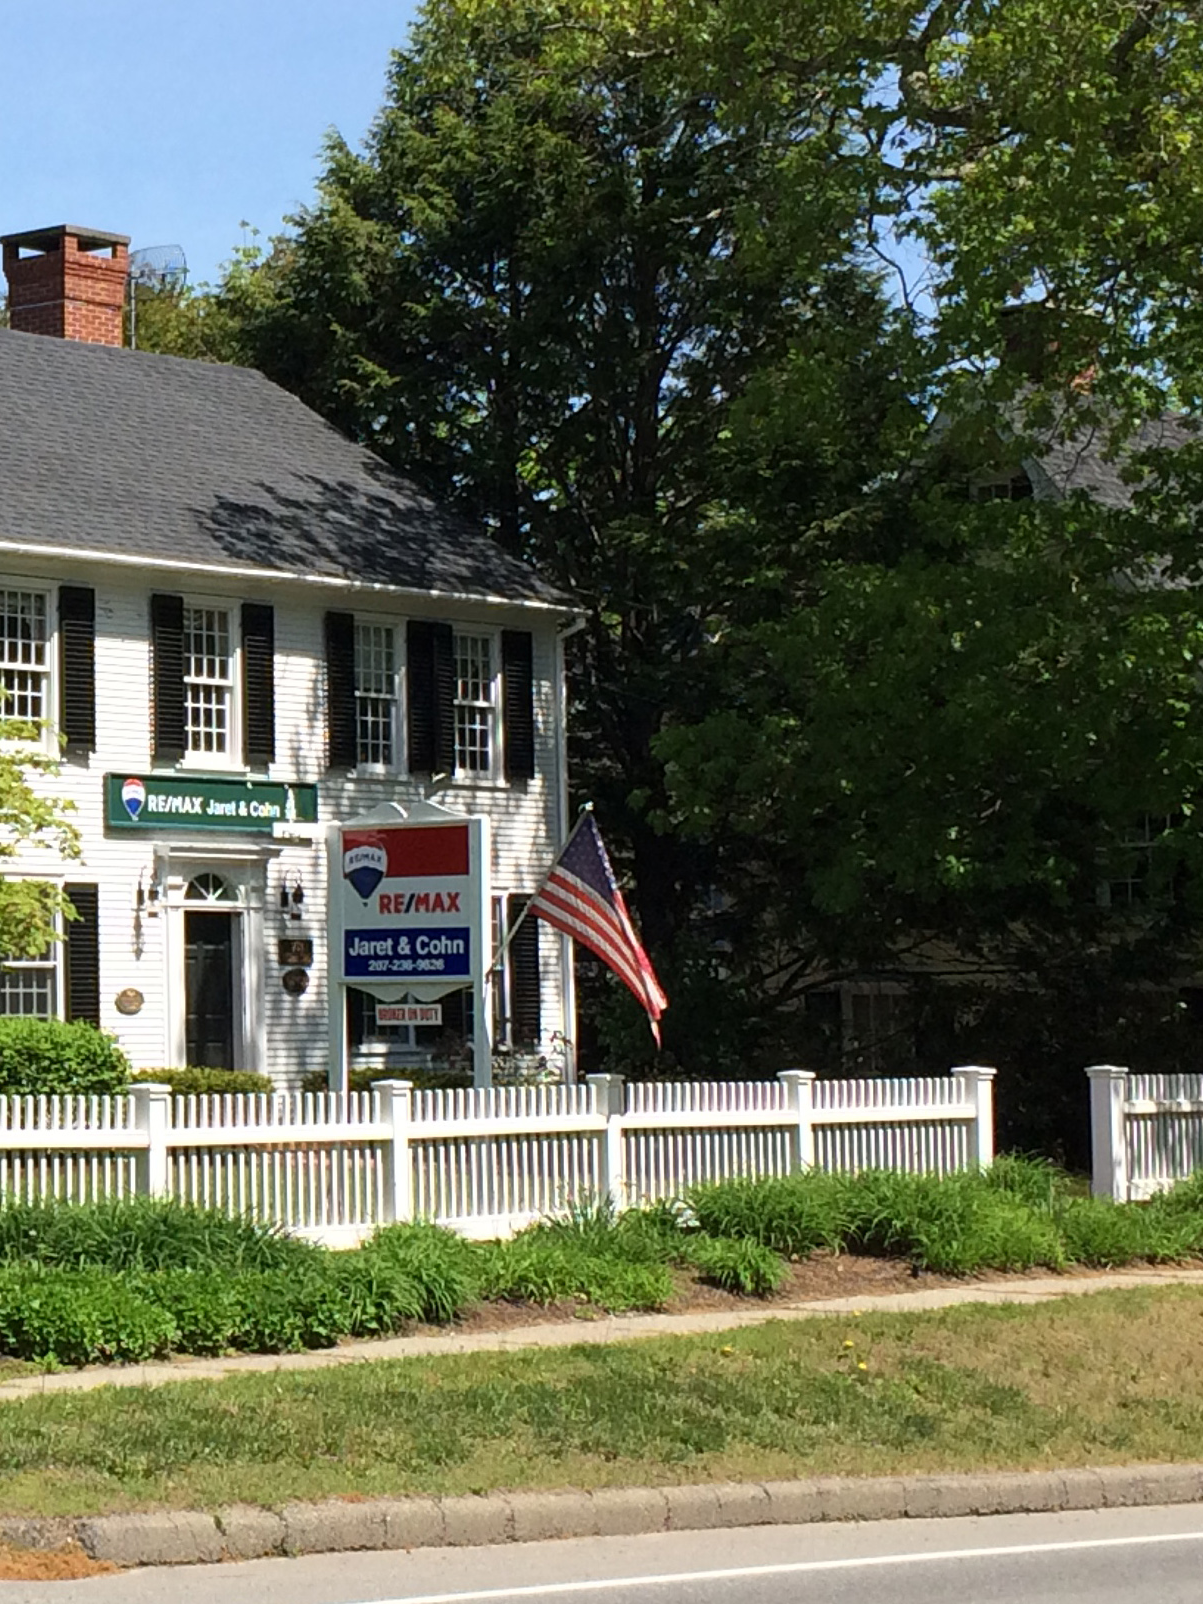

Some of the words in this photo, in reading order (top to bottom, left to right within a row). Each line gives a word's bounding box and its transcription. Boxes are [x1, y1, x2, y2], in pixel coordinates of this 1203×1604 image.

[147, 794, 204, 815] RE/MAX
[206, 798, 237, 816] Jaret
[237, 800, 248, 817] &
[250, 801, 280, 818] Cohn
[378, 892, 461, 914] RE/MAX
[348, 937, 393, 957] Jaret
[397, 937, 411, 955] &
[416, 935, 464, 955] Cohn
